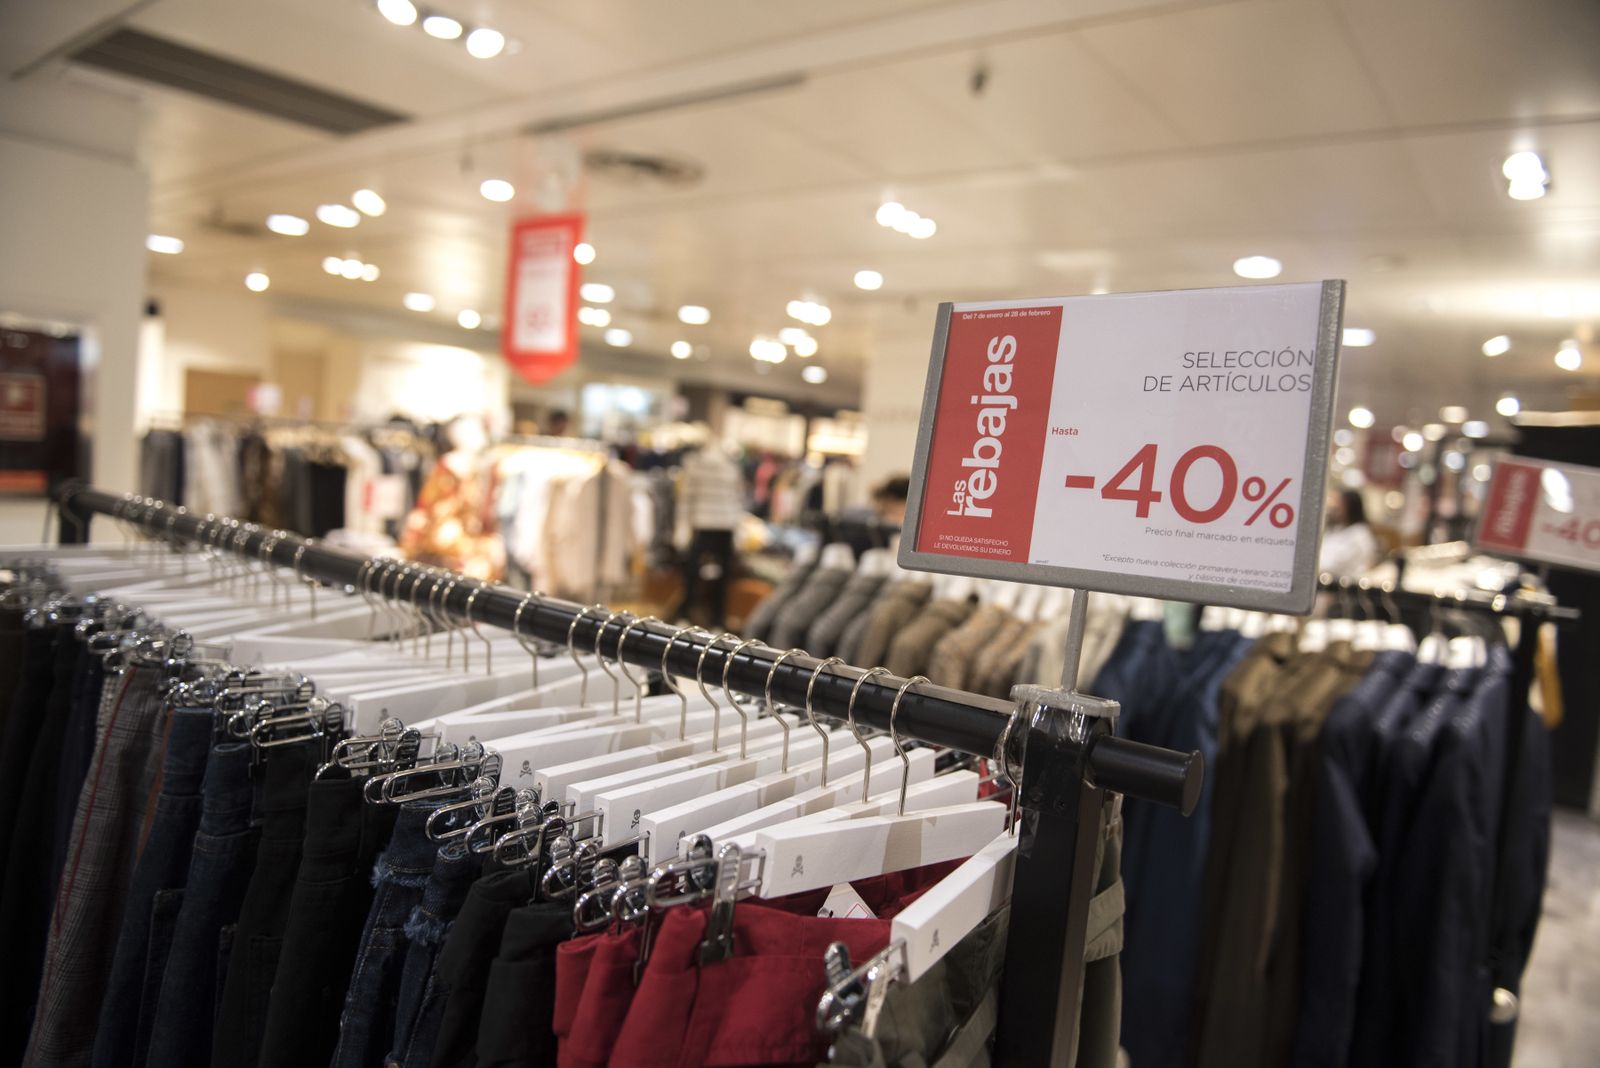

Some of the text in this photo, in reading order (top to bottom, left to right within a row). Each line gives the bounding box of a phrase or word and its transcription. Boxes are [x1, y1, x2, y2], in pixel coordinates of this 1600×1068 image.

[1182, 346, 1314, 369] SELECCIÓN
[1143, 371, 1312, 392] DE ARTÍCULOS
[961, 335, 1018, 518] rebajas
[1051, 426, 1079, 436] Hasta
[1064, 443, 1294, 529] -40%
[947, 479, 967, 516] Las
[973, 537, 1009, 547] SATISFECHO
[1145, 526, 1296, 547] Precio final marcado en etiqueta
[941, 543, 980, 553] DEVOLVEMOS
[988, 548, 1012, 556] DINERO
[1136, 558, 1159, 566] nueva
[1160, 560, 1197, 570] colección
[1227, 576, 1239, 585] de
